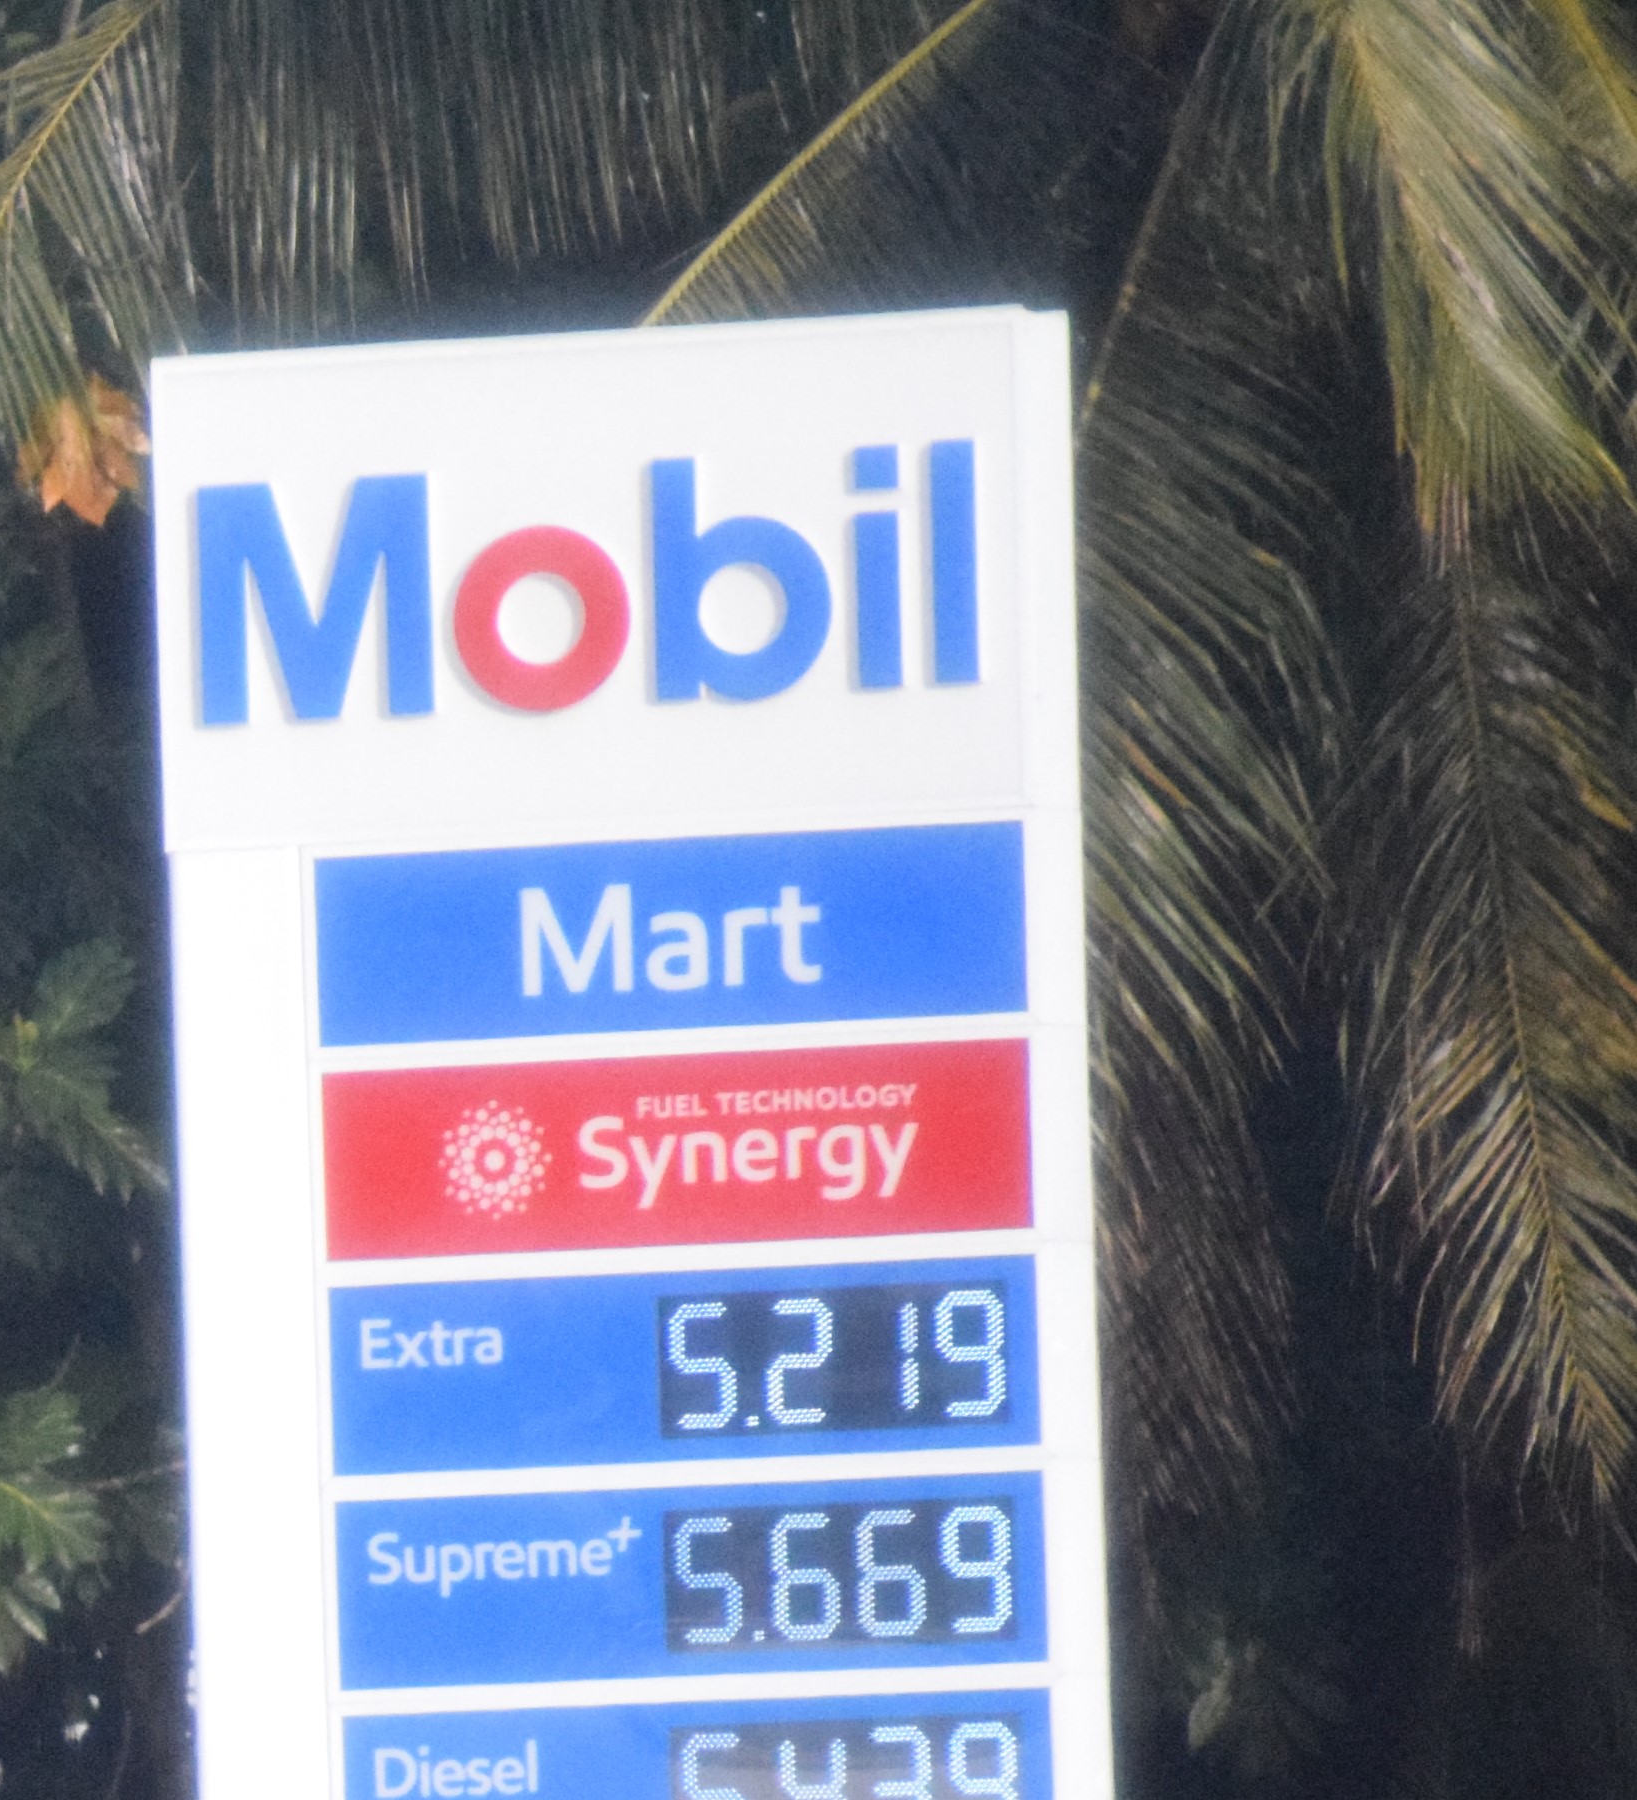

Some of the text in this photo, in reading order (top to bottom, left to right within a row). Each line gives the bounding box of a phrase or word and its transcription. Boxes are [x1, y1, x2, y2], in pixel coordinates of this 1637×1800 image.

[194, 438, 981, 728] Mobil
[518, 883, 823, 998] Mart
[635, 1083, 918, 1119] FUEL TECHNOLOGY
[577, 1115, 919, 1210] Synergy
[358, 1289, 1007, 1430] Extra 5.219
[672, 1505, 1013, 1643] 5.669
[374, 1738, 540, 1798] Diesel
